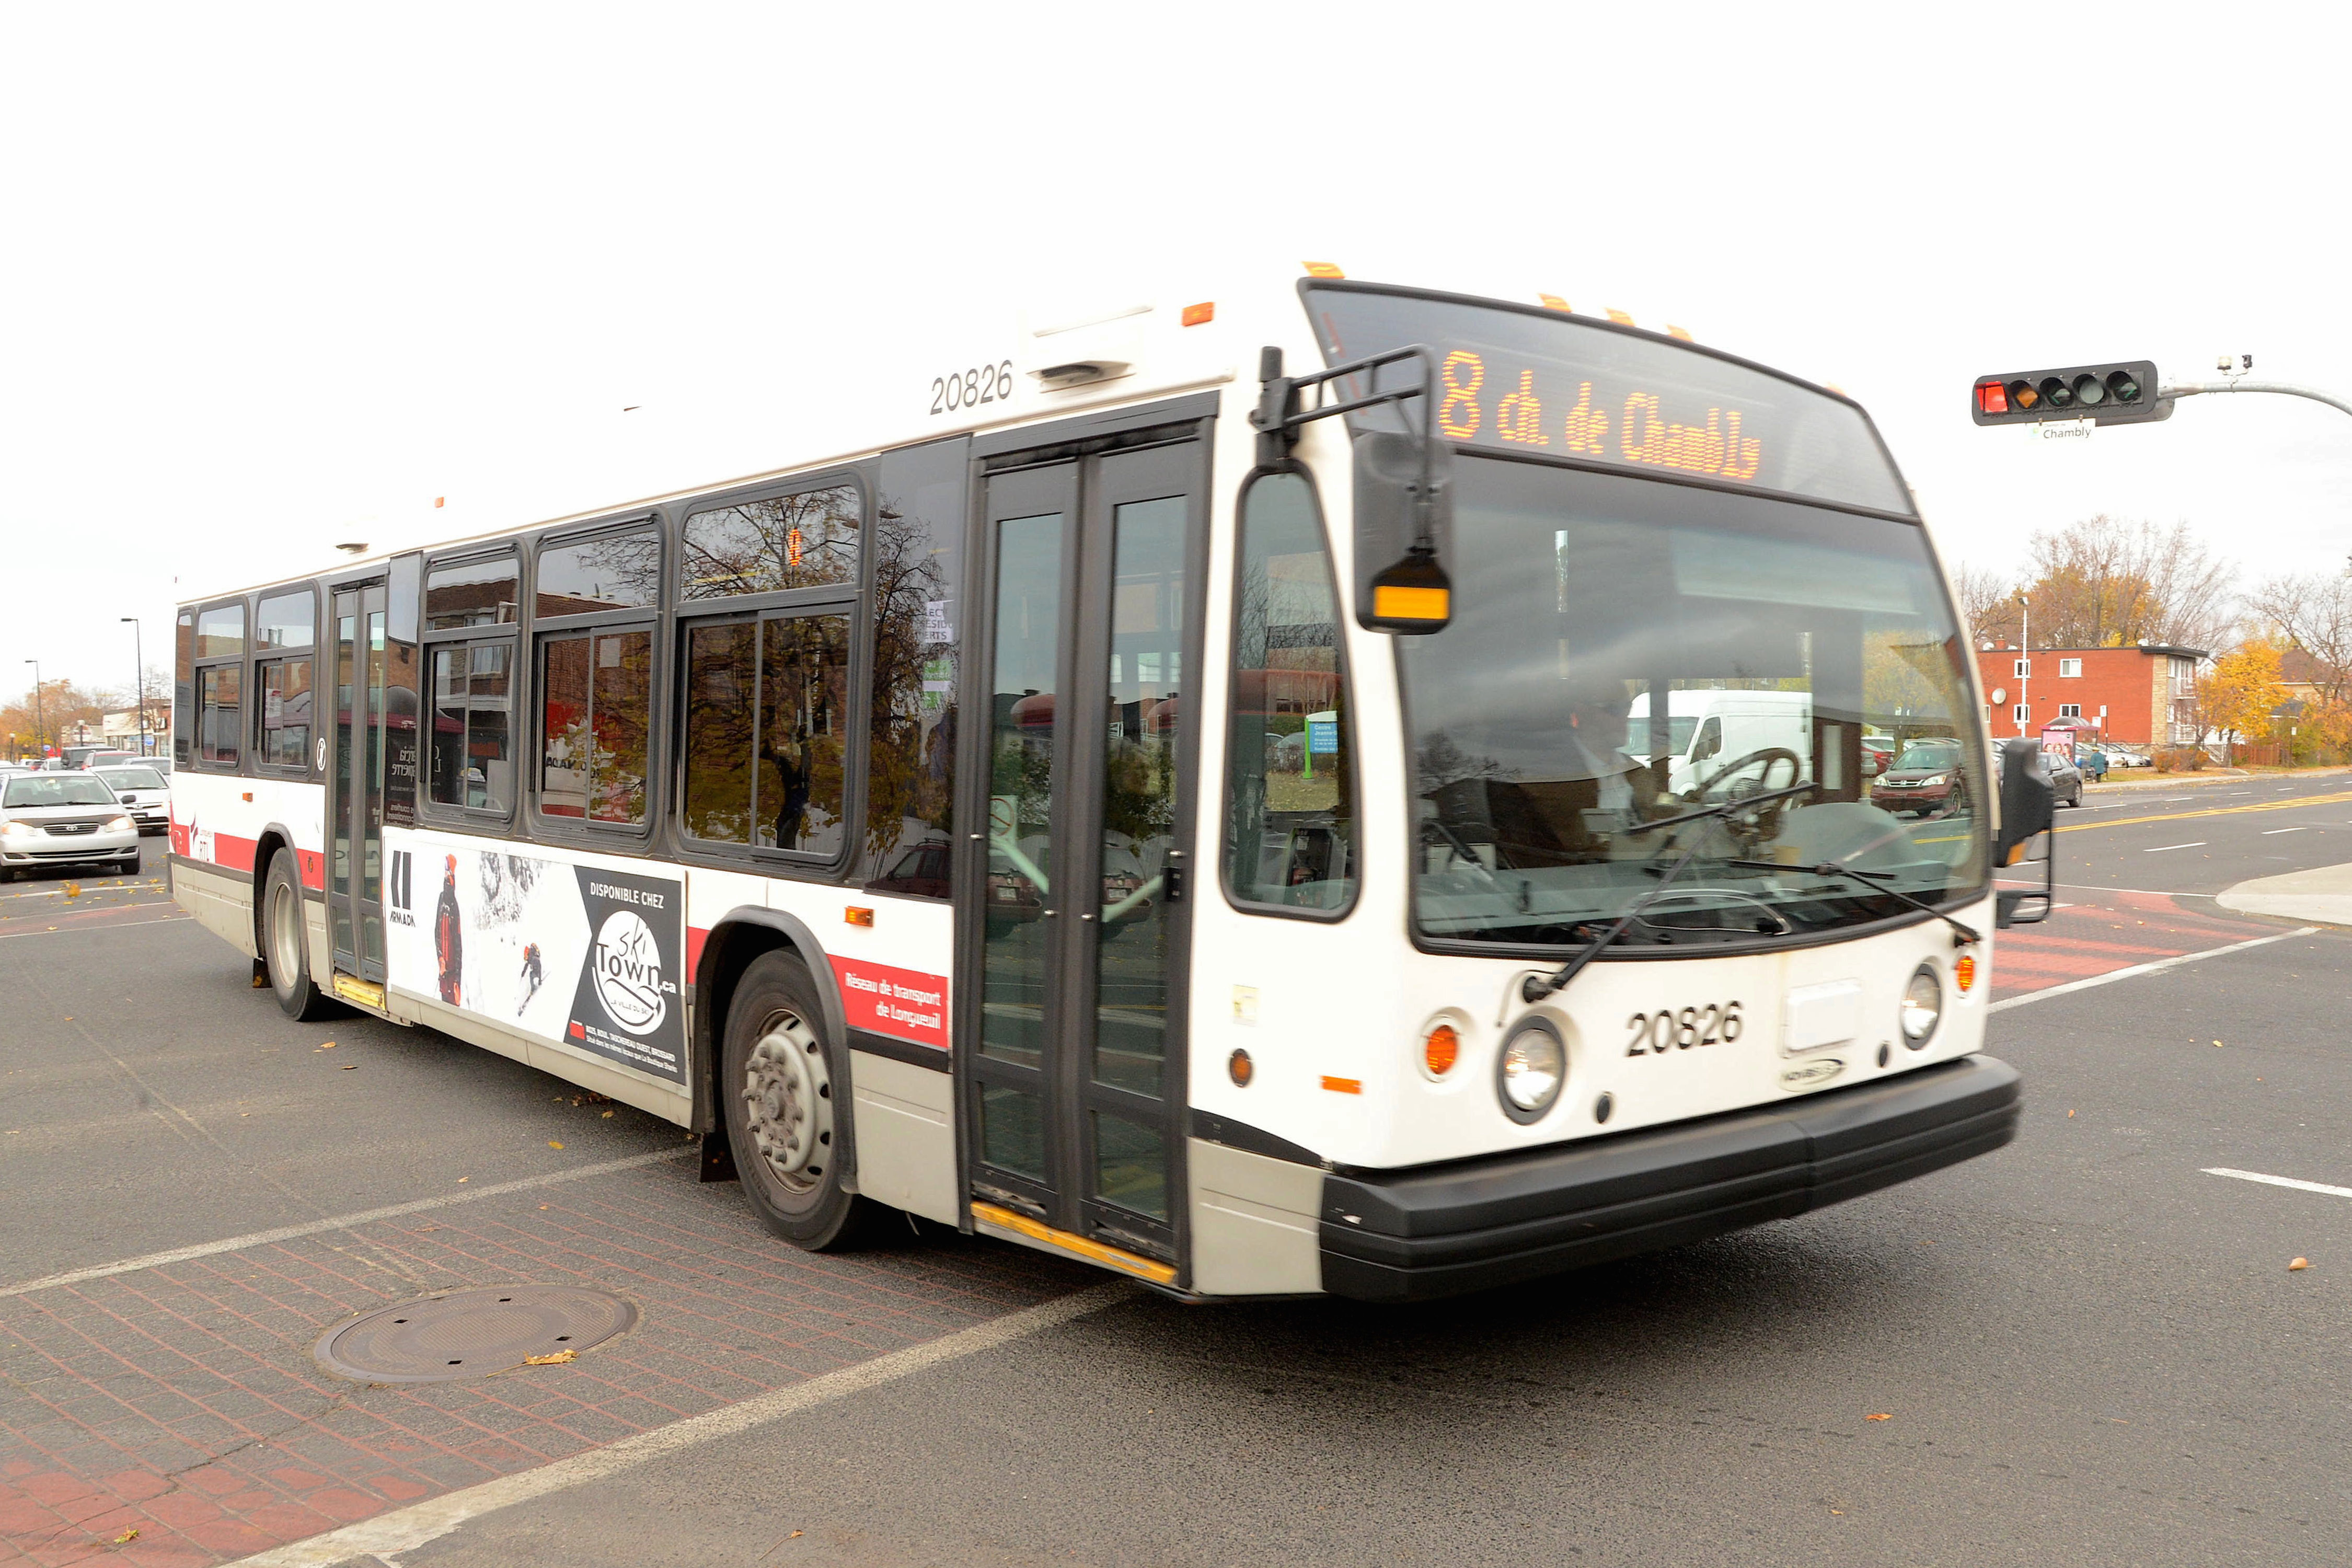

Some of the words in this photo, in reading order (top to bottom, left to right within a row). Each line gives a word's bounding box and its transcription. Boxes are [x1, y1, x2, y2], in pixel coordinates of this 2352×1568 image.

[930, 360, 1012, 415] 20826
[1439, 350, 1484, 438] 8
[1565, 382, 1609, 454] de
[1620, 392, 1761, 479] Chambly
[2043, 426, 2091, 439] Chambly
[590, 882, 639, 904] DISPONIBLE
[641, 892, 664, 909] CHEZ
[389, 910, 416, 927] ARMADA
[845, 972, 878, 993] Réseau
[879, 979, 892, 996] de
[893, 984, 941, 1006] transport
[876, 1001, 889, 1018] de
[890, 1004, 941, 1030] Longueuil
[1627, 1000, 1743, 1056] 20826
